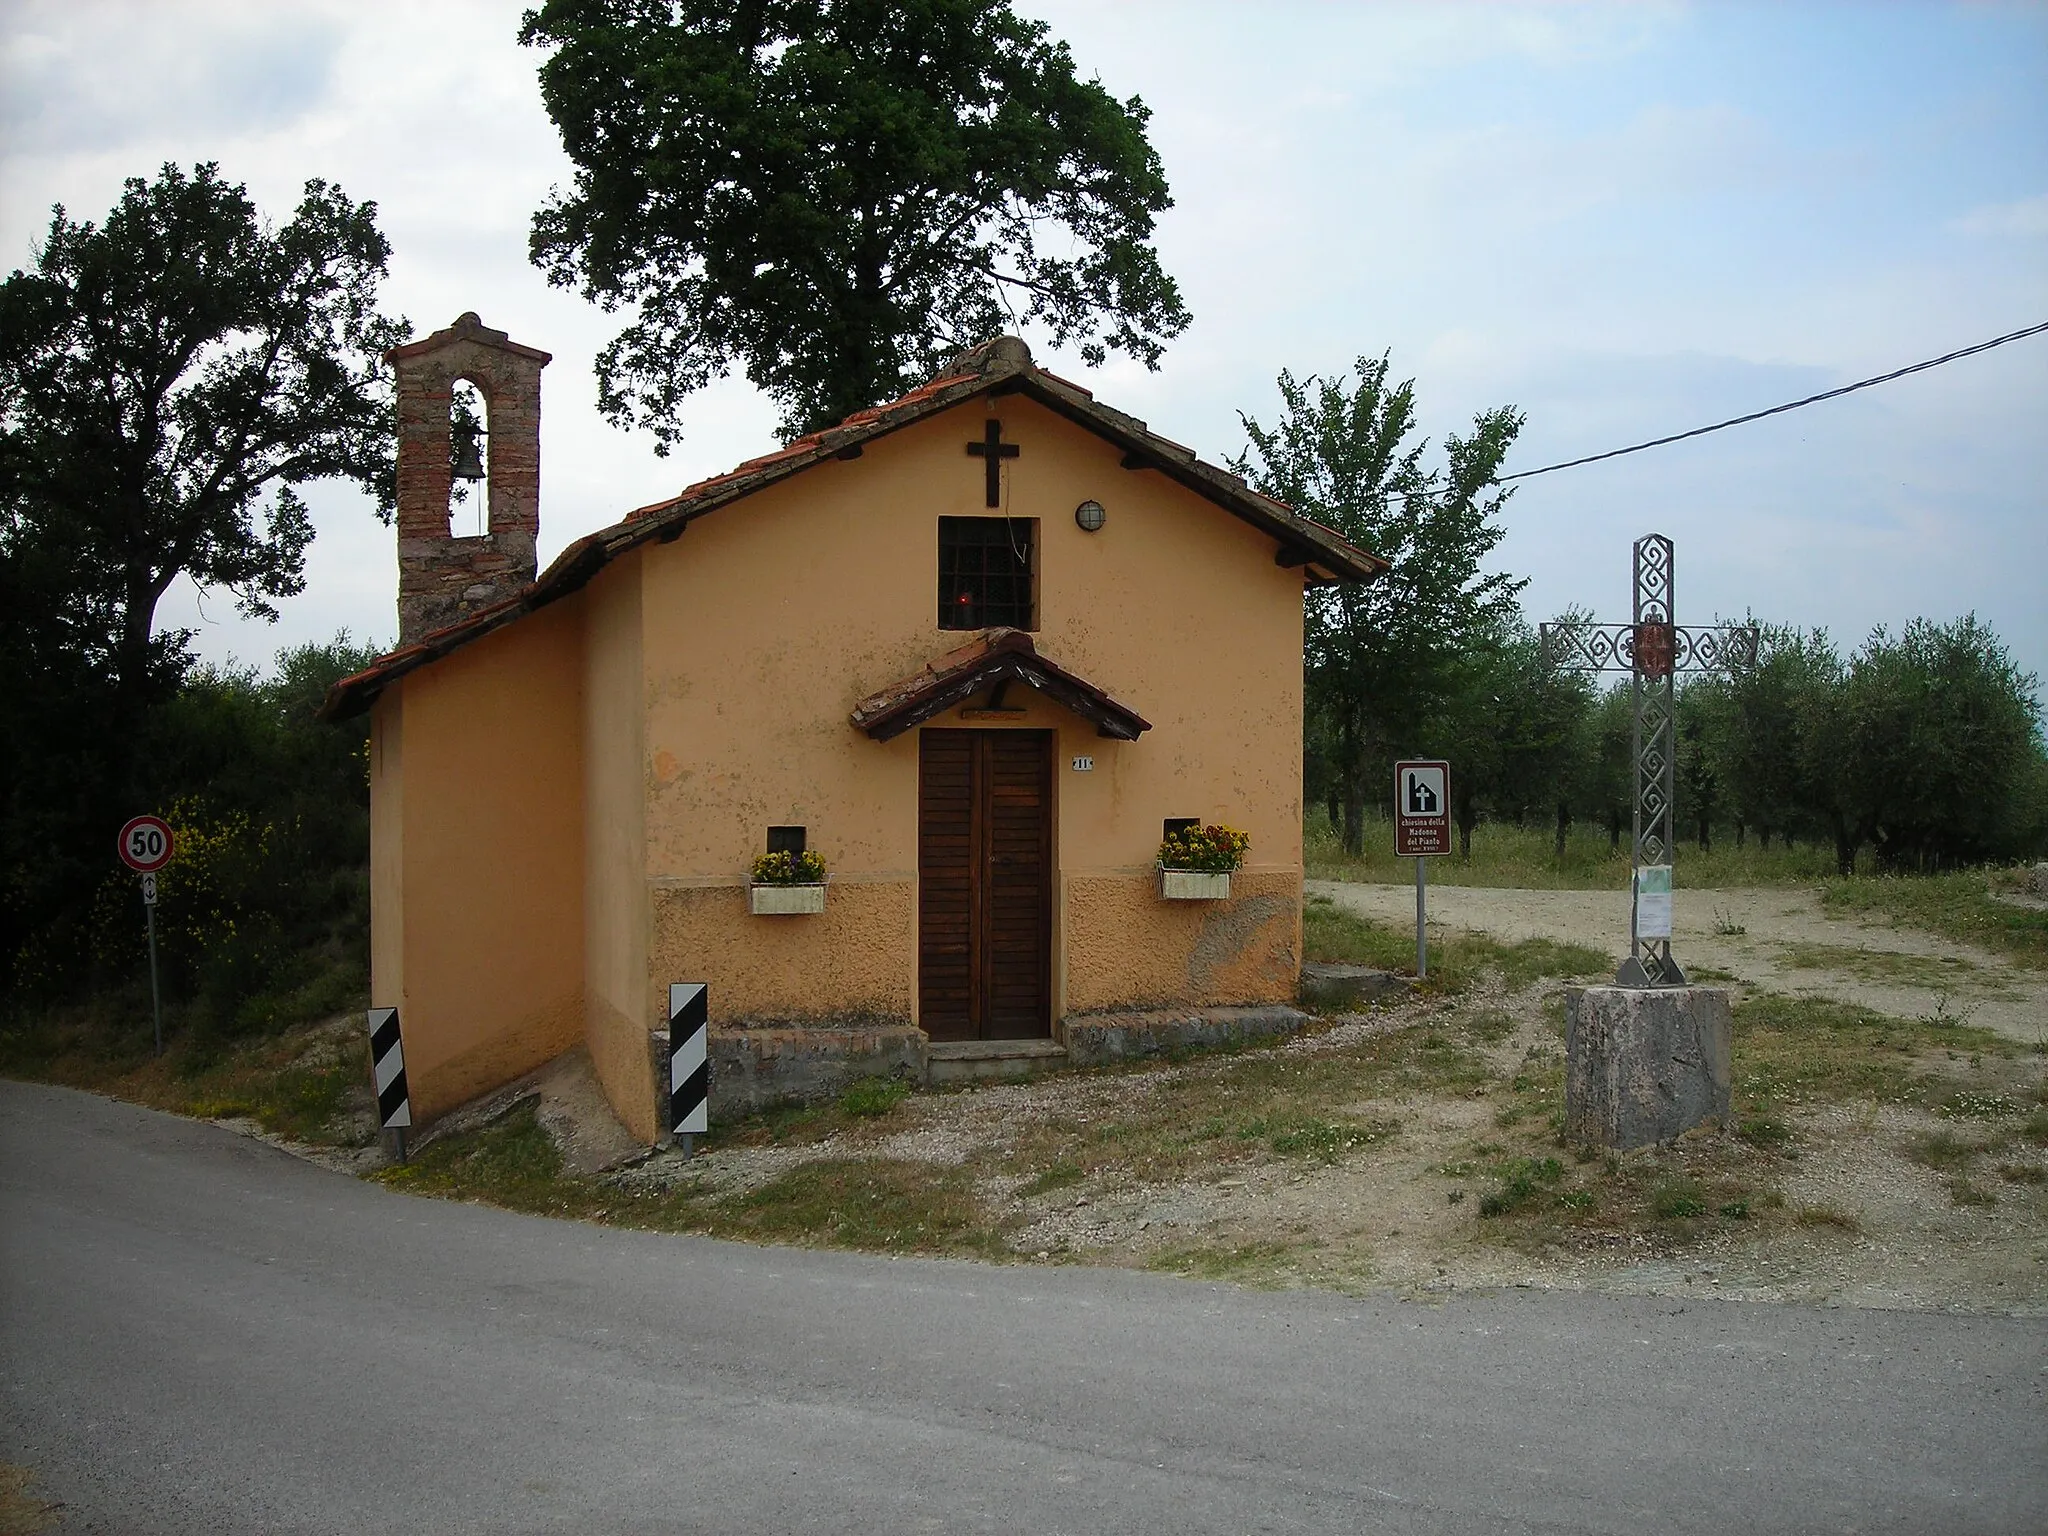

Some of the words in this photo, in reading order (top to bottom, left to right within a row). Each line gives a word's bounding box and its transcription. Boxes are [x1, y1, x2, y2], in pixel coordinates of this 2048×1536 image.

[1079, 759, 1087, 768] 11
[1401, 818, 1427, 826] chiesina
[1428, 818, 1445, 826] della
[1409, 828, 1437, 836] Madonna
[131, 831, 162, 857] 50
[1407, 837, 1418, 845] del
[1419, 837, 1440, 845] Pianto
